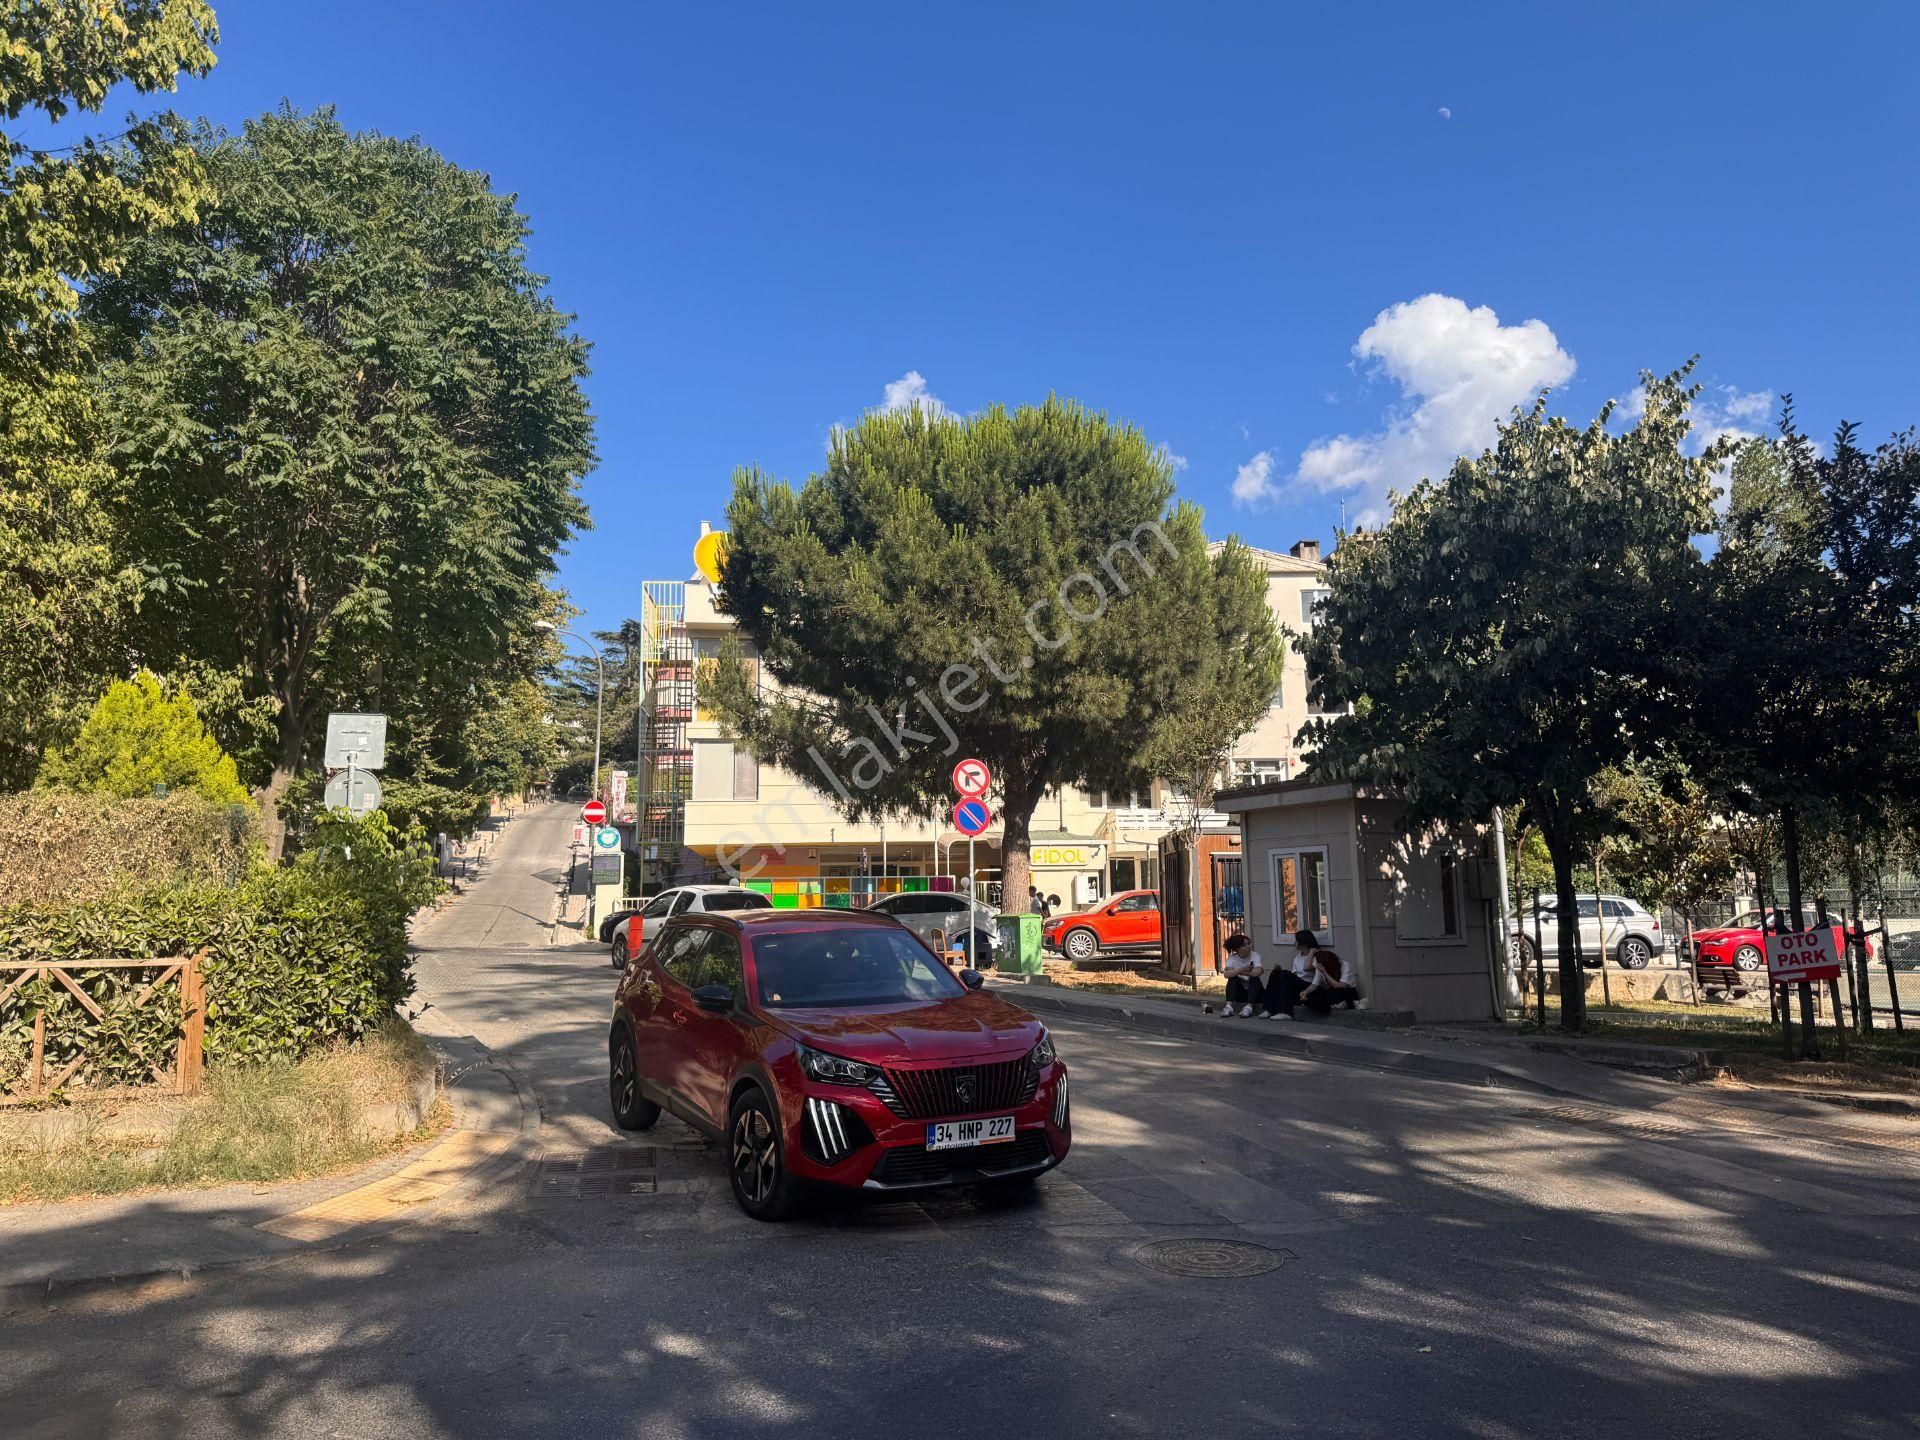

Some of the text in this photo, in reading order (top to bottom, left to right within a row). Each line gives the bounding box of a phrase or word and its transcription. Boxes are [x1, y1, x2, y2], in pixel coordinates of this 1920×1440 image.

[1780, 933, 1818, 949] OTO
[1777, 948, 1828, 967] PARK
[936, 1118, 1012, 1142] 34 HNP 227
